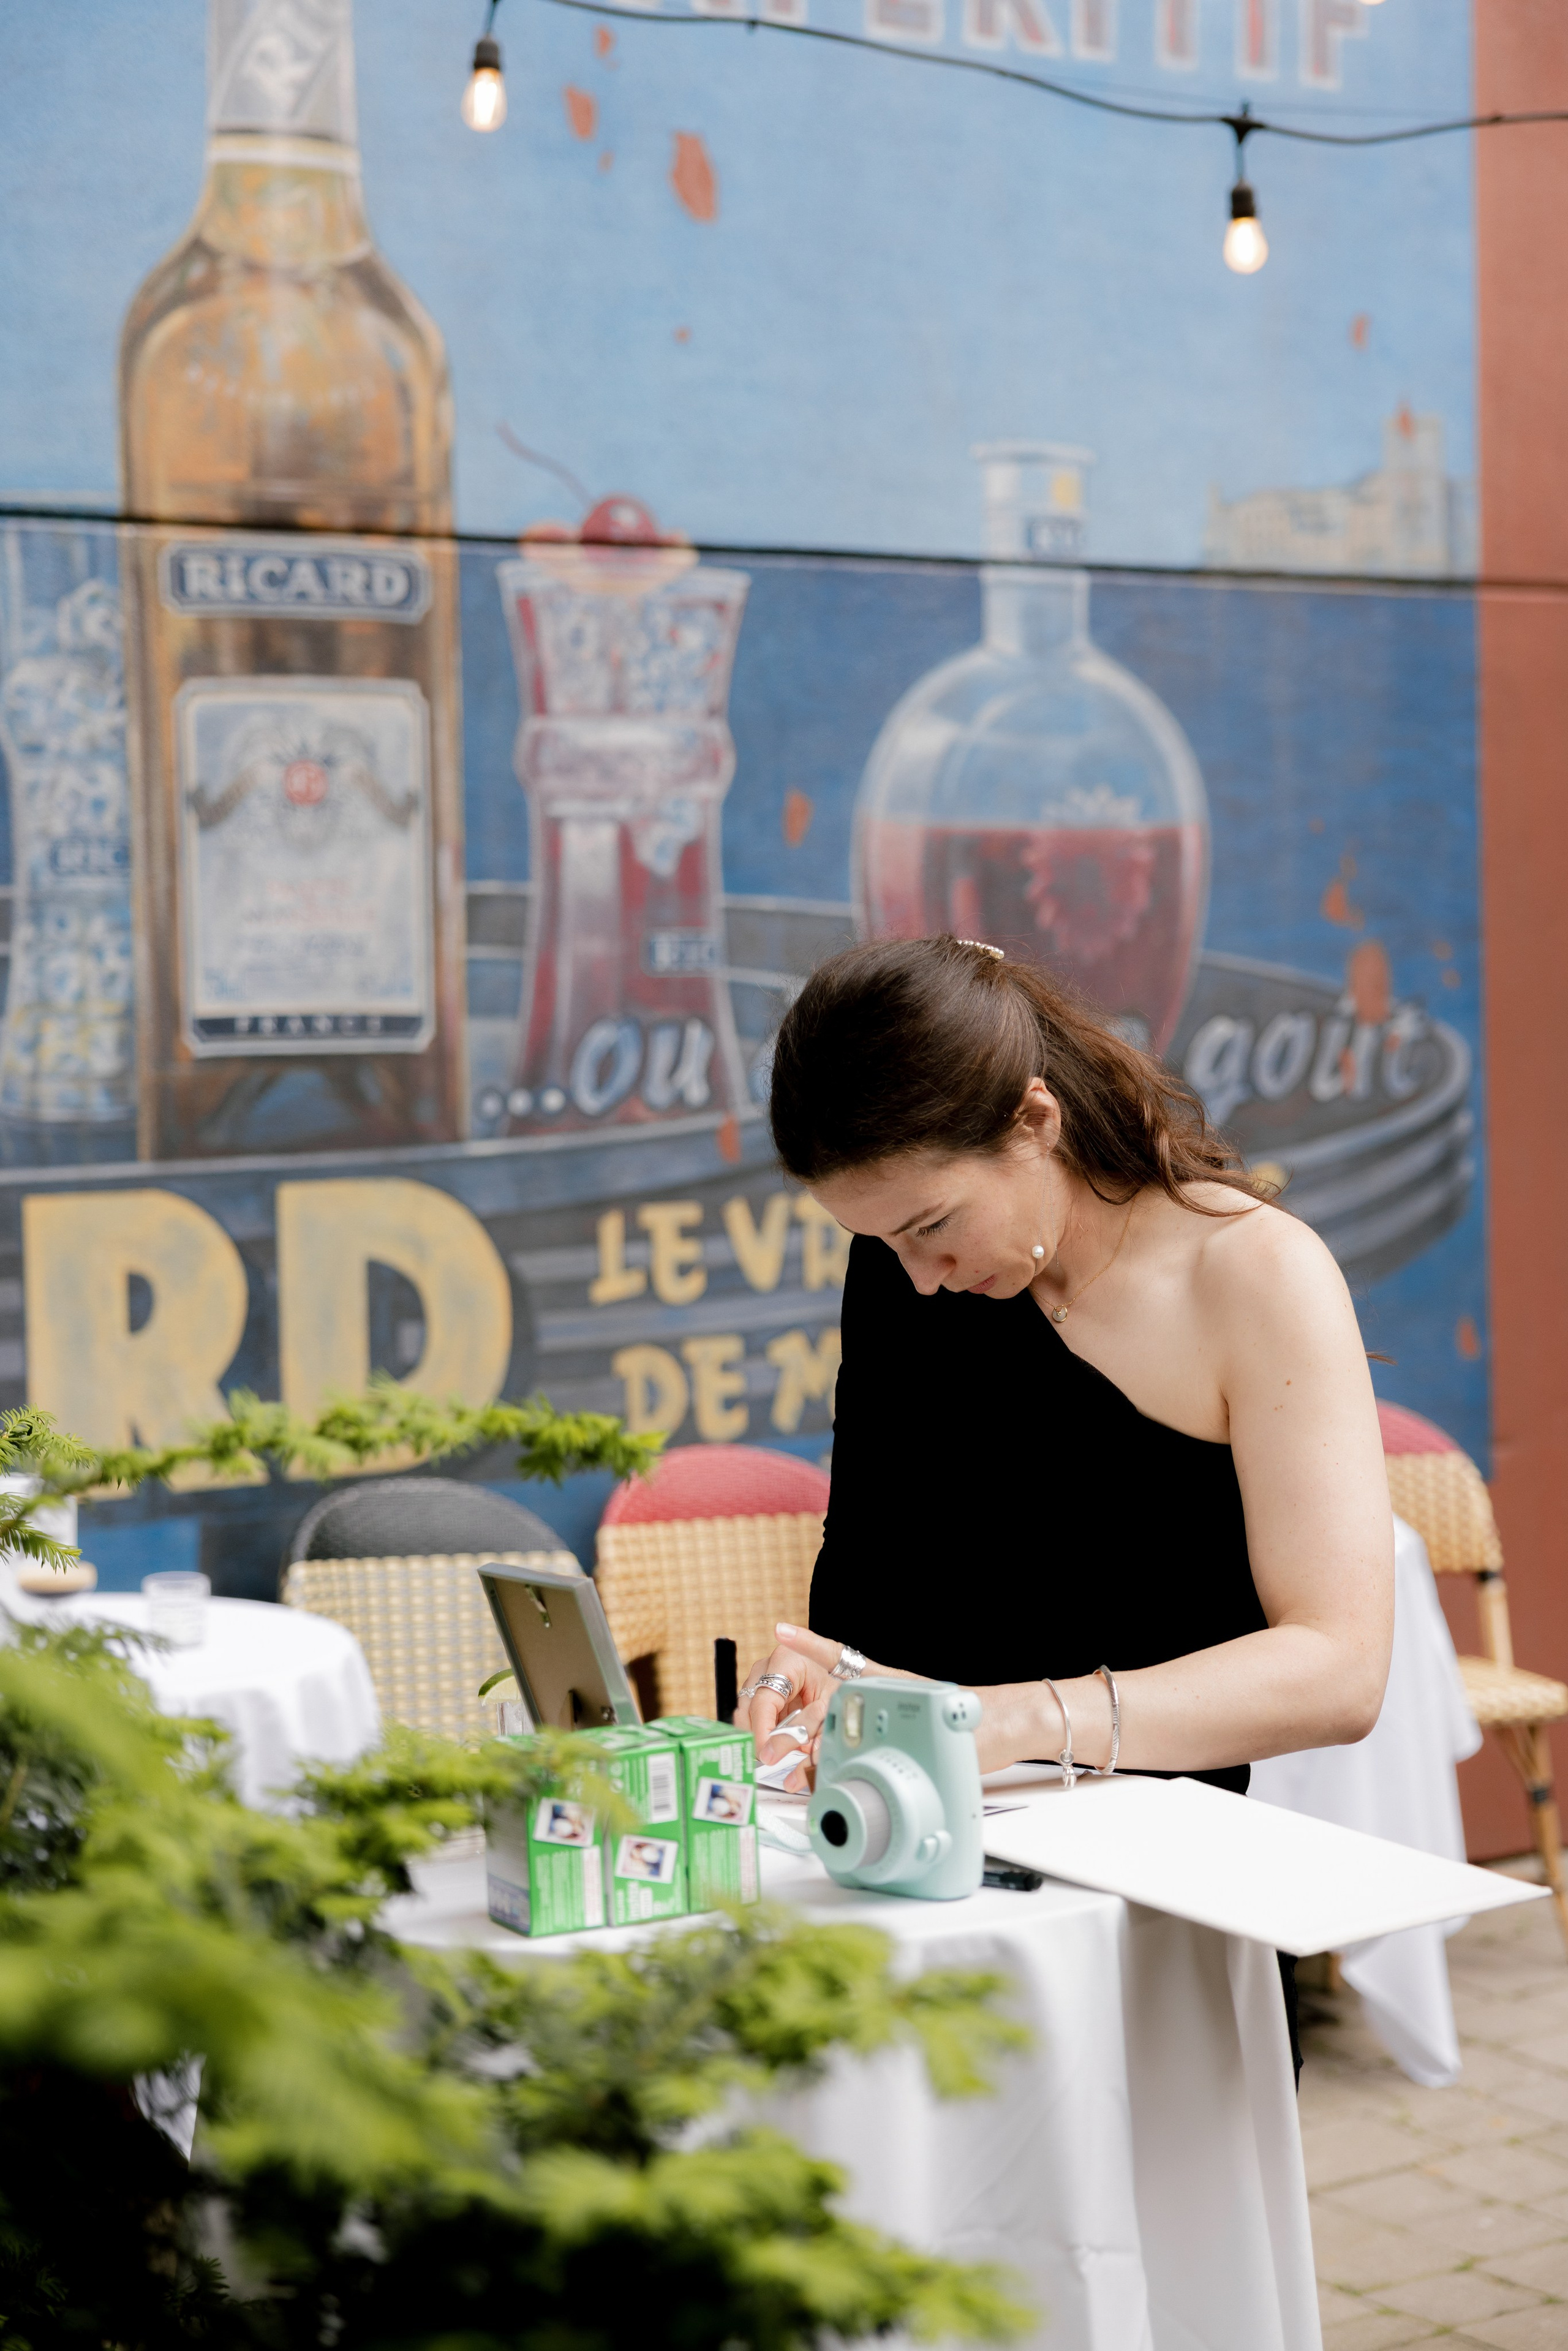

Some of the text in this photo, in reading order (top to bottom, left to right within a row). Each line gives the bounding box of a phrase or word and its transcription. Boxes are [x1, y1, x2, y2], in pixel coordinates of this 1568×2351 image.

[184, 554, 409, 608] RICARD
[588, 1199, 708, 1306] LE
[614, 1334, 750, 1442] DE
